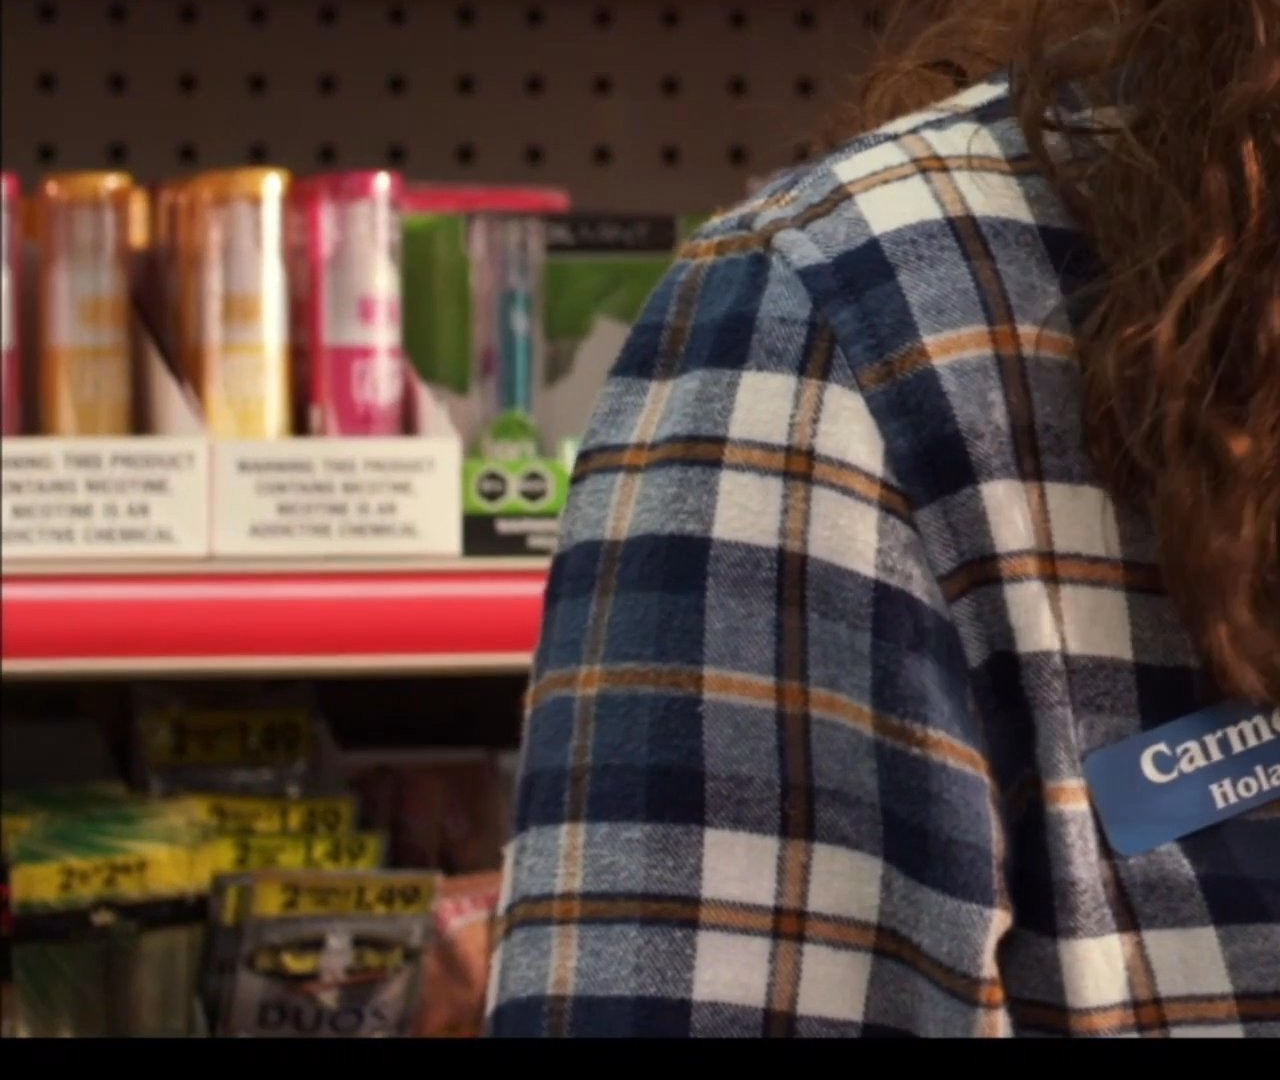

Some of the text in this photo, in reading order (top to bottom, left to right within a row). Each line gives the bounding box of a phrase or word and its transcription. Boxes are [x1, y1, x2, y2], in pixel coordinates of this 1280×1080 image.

[64, 453, 103, 470] THIS
[110, 452, 196, 470] PRODUCT
[323, 458, 355, 472] THIS
[363, 458, 435, 473] PRODUCT
[256, 480, 334, 495] CONTAINS
[11, 502, 150, 519] NICOTINE IS AN
[277, 502, 396, 517] NICOTINE IS AN
[249, 524, 332, 539] ADDICTIVE
[280, 884, 300, 911] 2
[353, 886, 423, 911] 1.49
